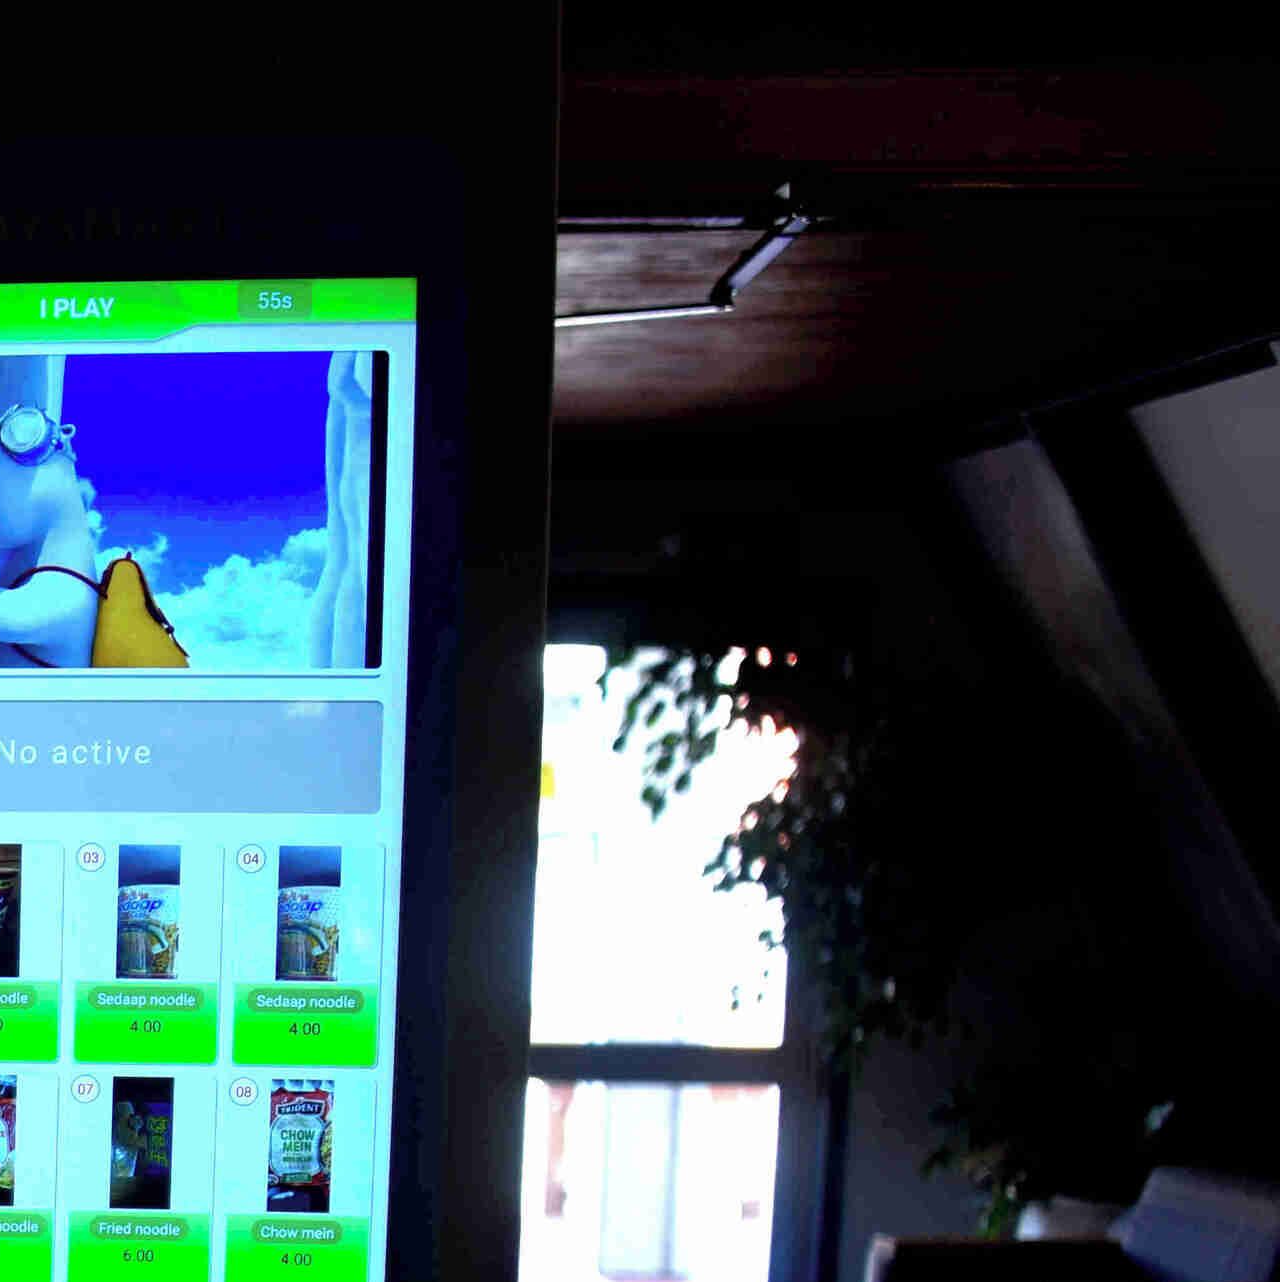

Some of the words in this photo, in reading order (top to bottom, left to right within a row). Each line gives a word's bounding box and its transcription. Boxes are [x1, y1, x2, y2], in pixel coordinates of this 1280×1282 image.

[52, 297, 114, 319] PLAY
[258, 291, 293, 311] 55s
[52, 738, 152, 765] active
[83, 851, 100, 864] 03
[243, 852, 260, 866] 04
[96, 993, 149, 1010] Sedaap
[150, 992, 197, 1008] noodle
[255, 994, 308, 1011] Sedaap
[309, 994, 356, 1010] noodle
[77, 1083, 94, 1096] 07
[235, 1085, 253, 1098] 08
[280, 1129, 316, 1141] CHOW
[283, 1141, 313, 1154] MEIN
[98, 1221, 132, 1236] Fried
[134, 1222, 181, 1237] noodle
[259, 1225, 298, 1240] Chow
[301, 1226, 336, 1241] mein
